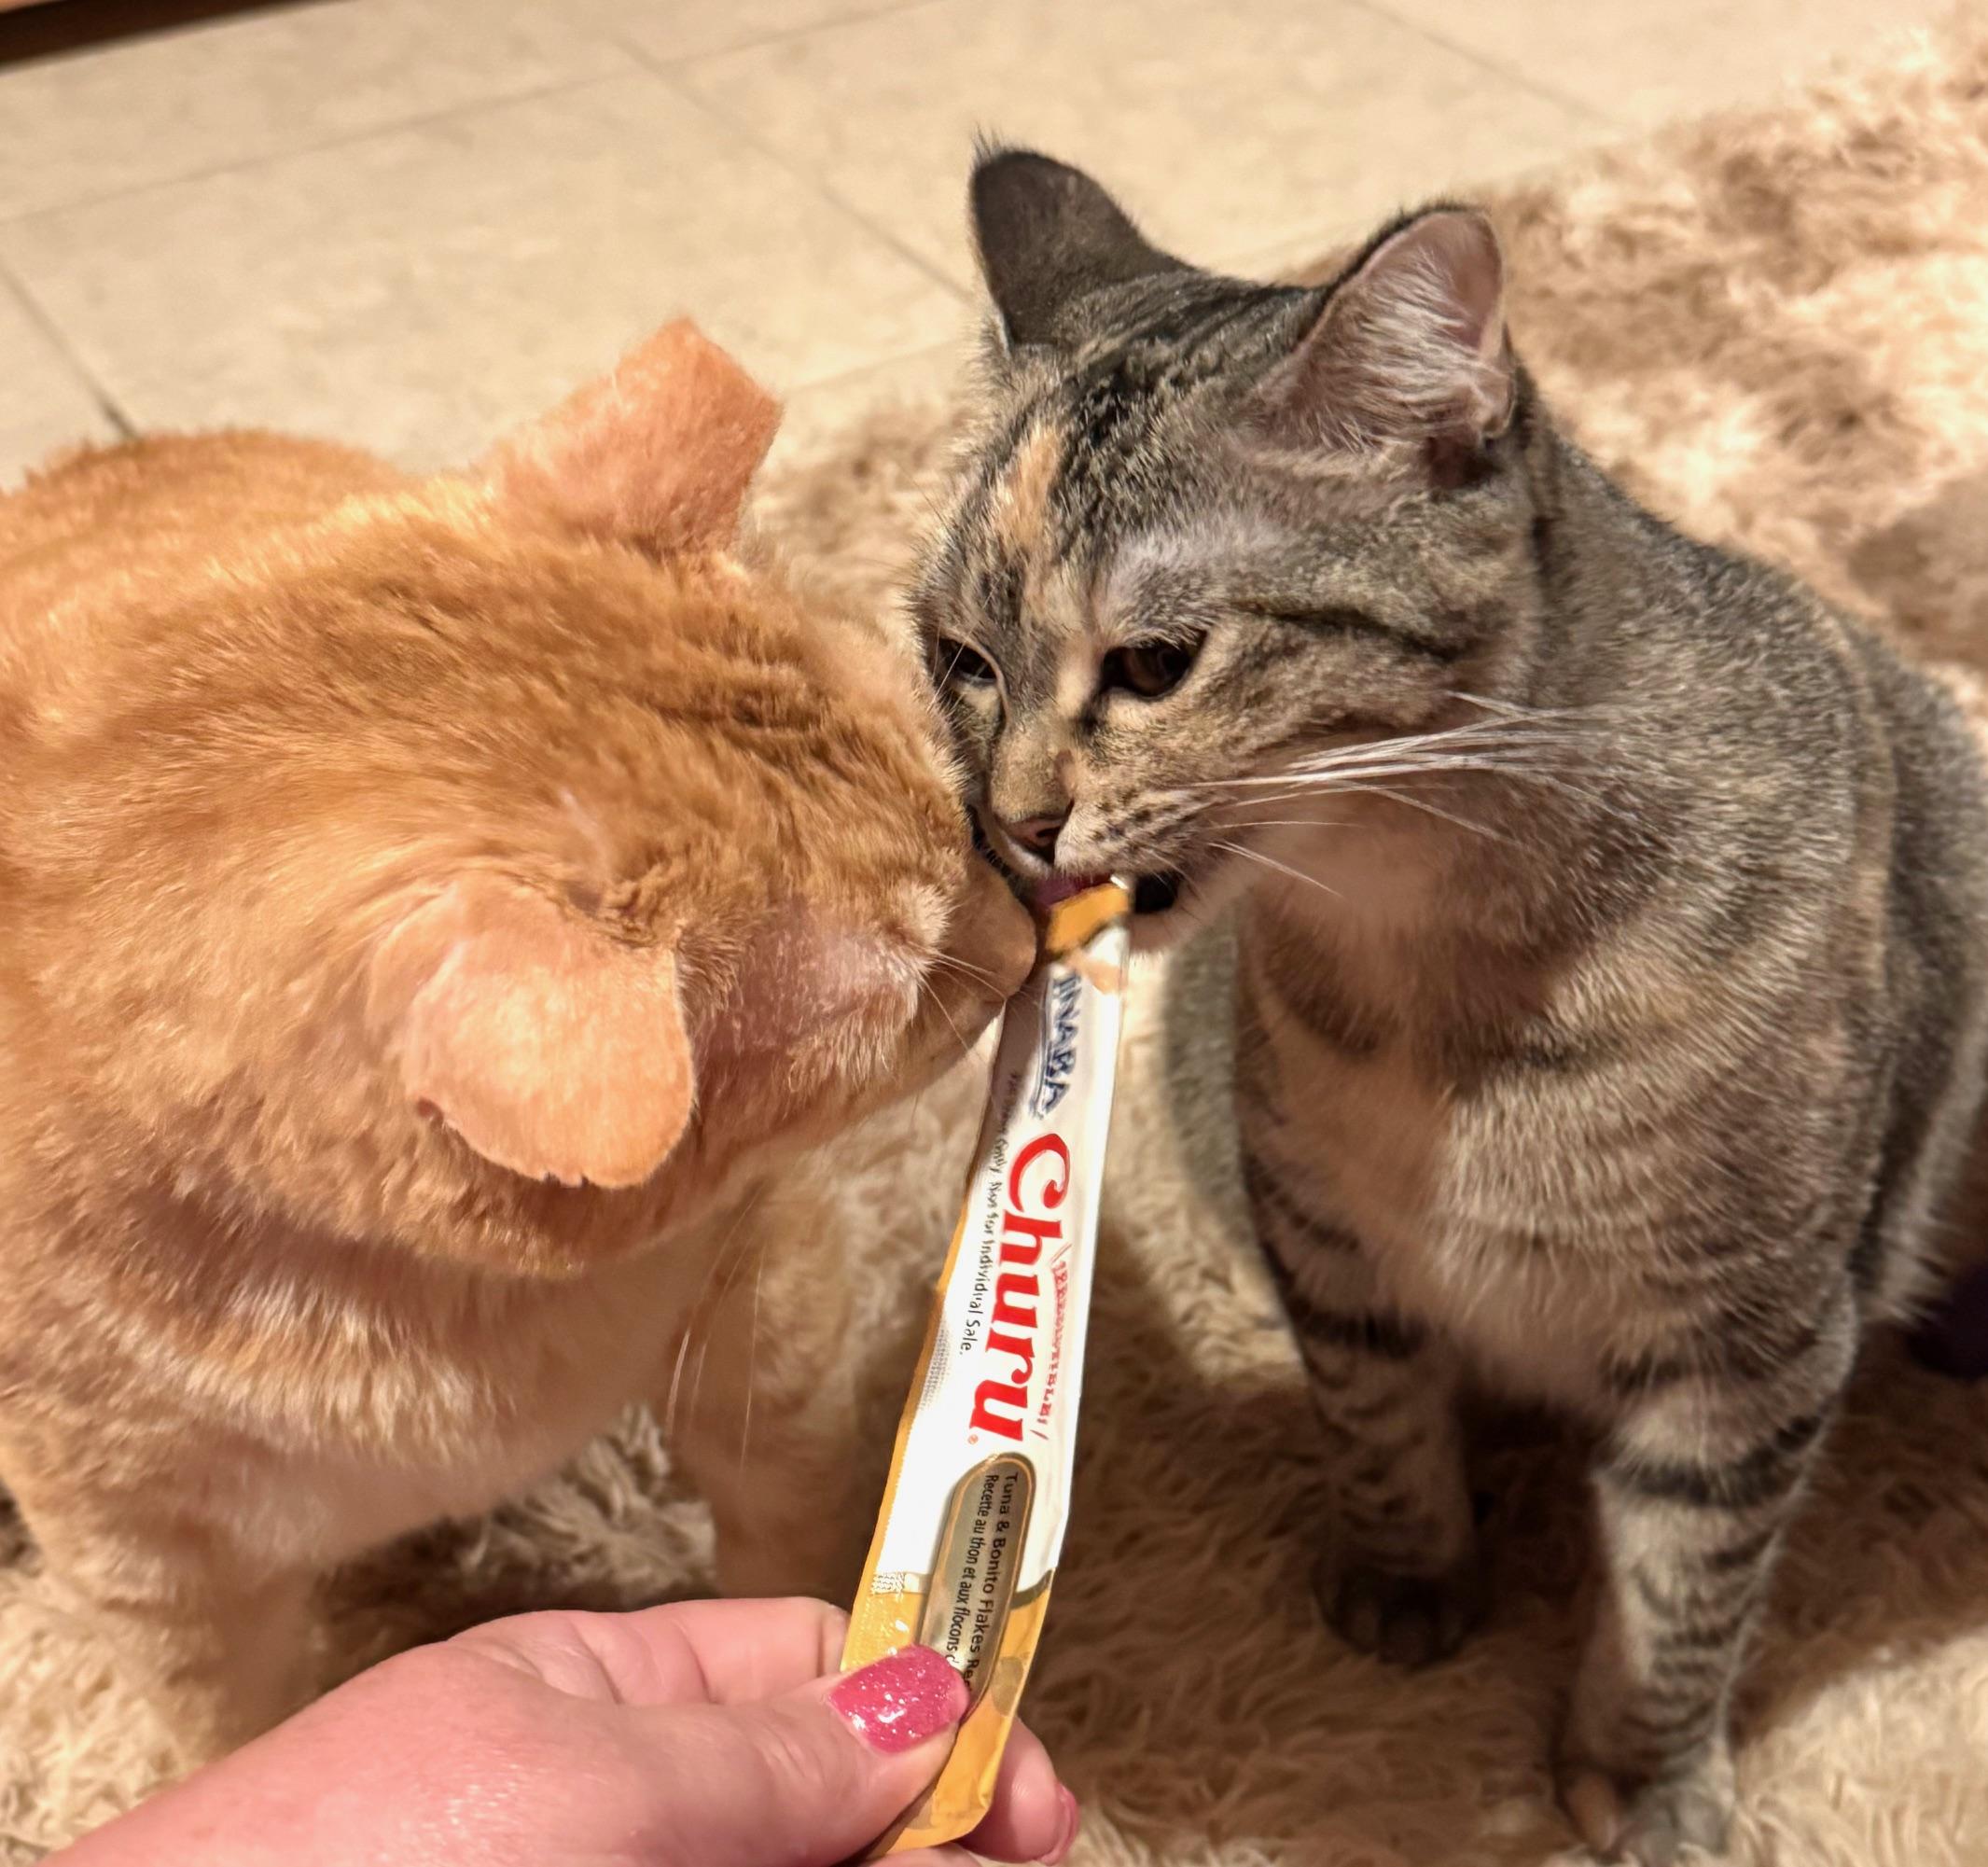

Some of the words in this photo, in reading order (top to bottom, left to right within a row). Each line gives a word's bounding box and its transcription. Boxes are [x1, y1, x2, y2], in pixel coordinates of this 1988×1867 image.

[1042, 972, 1082, 1115] INABA
[967, 1240, 994, 1314] Individual
[968, 1133, 1070, 1442] Churu
[959, 1319, 980, 1355] Sale.
[979, 1474, 1000, 1517] Recette
[998, 1471, 1019, 1516] Tuna
[973, 1518, 987, 1535] au
[995, 1520, 1010, 1533] &
[967, 1537, 987, 1565] thon
[981, 1538, 1007, 1594] Bonito
[955, 1583, 972, 1609] aux
[963, 1567, 976, 1581] et
[946, 1607, 971, 1652] flocons
[969, 1599, 994, 1653] Flakes
